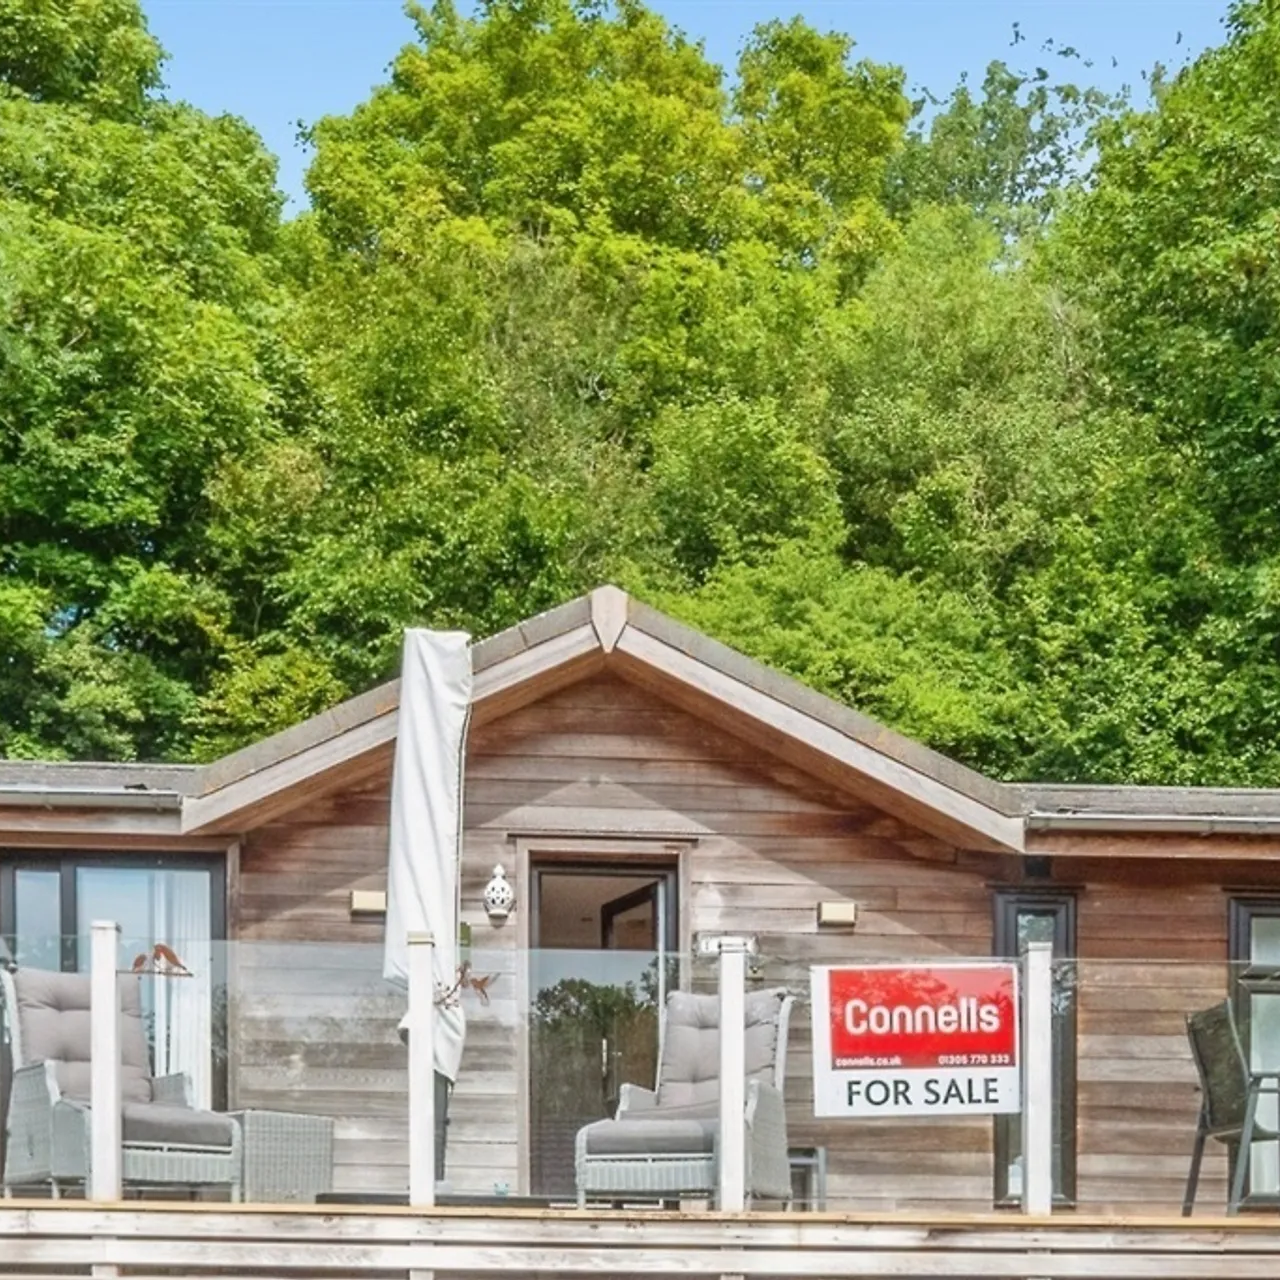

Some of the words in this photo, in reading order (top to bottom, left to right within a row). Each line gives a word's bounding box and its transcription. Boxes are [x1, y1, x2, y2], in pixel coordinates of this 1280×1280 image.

[844, 997, 1000, 1035] Connells
[835, 1055, 902, 1067] connells.co.uk
[938, 1054, 968, 1065] 01305
[970, 1054, 989, 1065] 770
[990, 1054, 1010, 1065] 333
[847, 1080, 913, 1106] FOR
[924, 1078, 999, 1105] SALE
